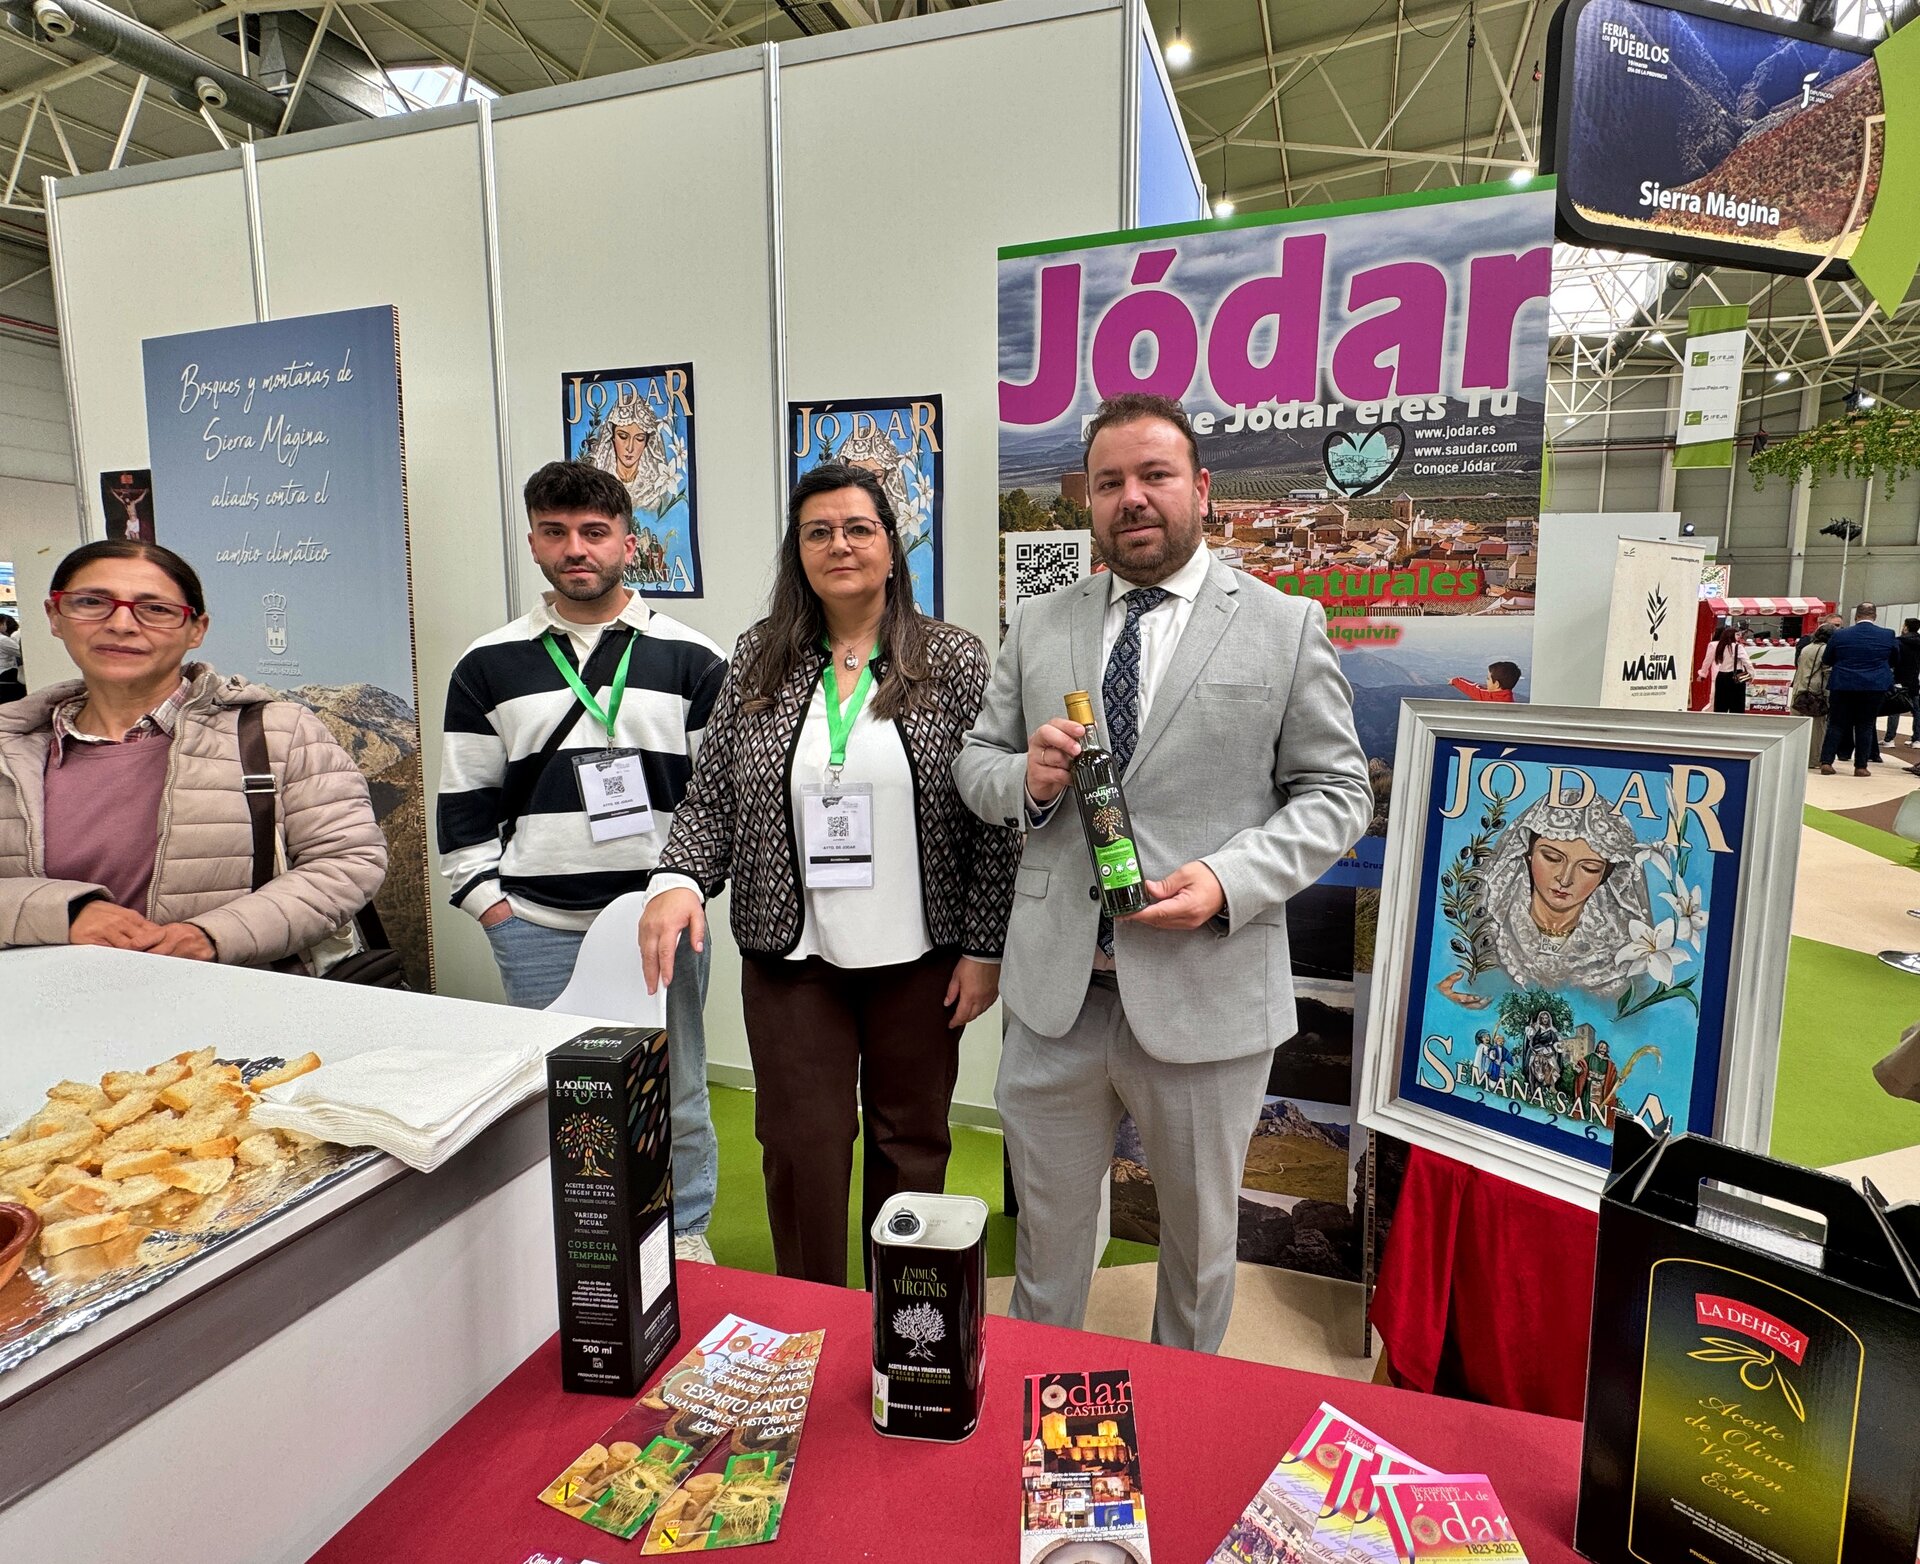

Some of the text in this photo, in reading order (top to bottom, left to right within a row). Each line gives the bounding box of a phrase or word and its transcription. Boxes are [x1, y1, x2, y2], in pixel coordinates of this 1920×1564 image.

[1602, 22, 1628, 38] FERIA
[1610, 36, 1670, 64] PUEBLOS
[1639, 180, 1780, 228] Sierra Mágina
[998, 233, 1553, 426] Jódar
[180, 348, 354, 414] Bosques y montañas de
[566, 368, 694, 426] JÓDAR
[1225, 394, 1344, 433] Jódar
[1356, 395, 1448, 424] eres
[794, 401, 942, 458] JÓDAR
[1415, 424, 1496, 440] www.jodar.es
[203, 414, 330, 468] Sierra Mágina,
[1414, 442, 1518, 457] www.saudar.com
[1414, 460, 1496, 475] Conoce Jódar
[212, 470, 330, 510] aliados contra el
[216, 530, 331, 566] cambio climático
[1276, 566, 1478, 598] naturales
[1327, 626, 1400, 644] alquivir
[1650, 652, 1667, 662] sierra
[1084, 787, 1119, 800] LAQUINTA
[1438, 746, 1734, 854] JÓDAR
[1351, 860, 1360, 868] la
[1420, 1035, 1546, 1109] SEMANA
[556, 1080, 613, 1091] LAQUINTA
[556, 1090, 613, 1099] ESENCIA
[574, 1212, 608, 1220] VARIEDAD
[568, 1240, 618, 1251] COSECHA
[568, 1251, 618, 1262] TEMPRANA
[902, 1265, 938, 1282] ANIMUS
[892, 1279, 948, 1298] VIRGINIS
[1699, 1301, 1802, 1354] LA DEHESA
[583, 1345, 599, 1353] 500
[712, 1360, 772, 1383] MUSEOGRÁFICA
[736, 1356, 782, 1373] COLECCIÓN
[703, 1370, 747, 1391] ARTESANÍA
[746, 1384, 764, 1394] DEL
[791, 1381, 810, 1390] DEL
[664, 1394, 676, 1404] EN
[687, 1402, 724, 1419] HISTORIA
[686, 1384, 749, 1412] ESPARTO
[741, 1410, 804, 1427] HISTORIA DE
[1024, 1372, 1132, 1453] Jódar
[1064, 1404, 1128, 1417] CASTILLO
[1698, 1397, 1785, 1442] Aceite
[1684, 1416, 1796, 1473] de Oliva
[1696, 1437, 1784, 1493] Virgen
[1410, 1485, 1460, 1493] Bicentenario
[1412, 1491, 1488, 1502] BATALLA de
[1701, 1472, 1772, 1515] Extra
[1466, 1543, 1519, 1554] 1823-2023
